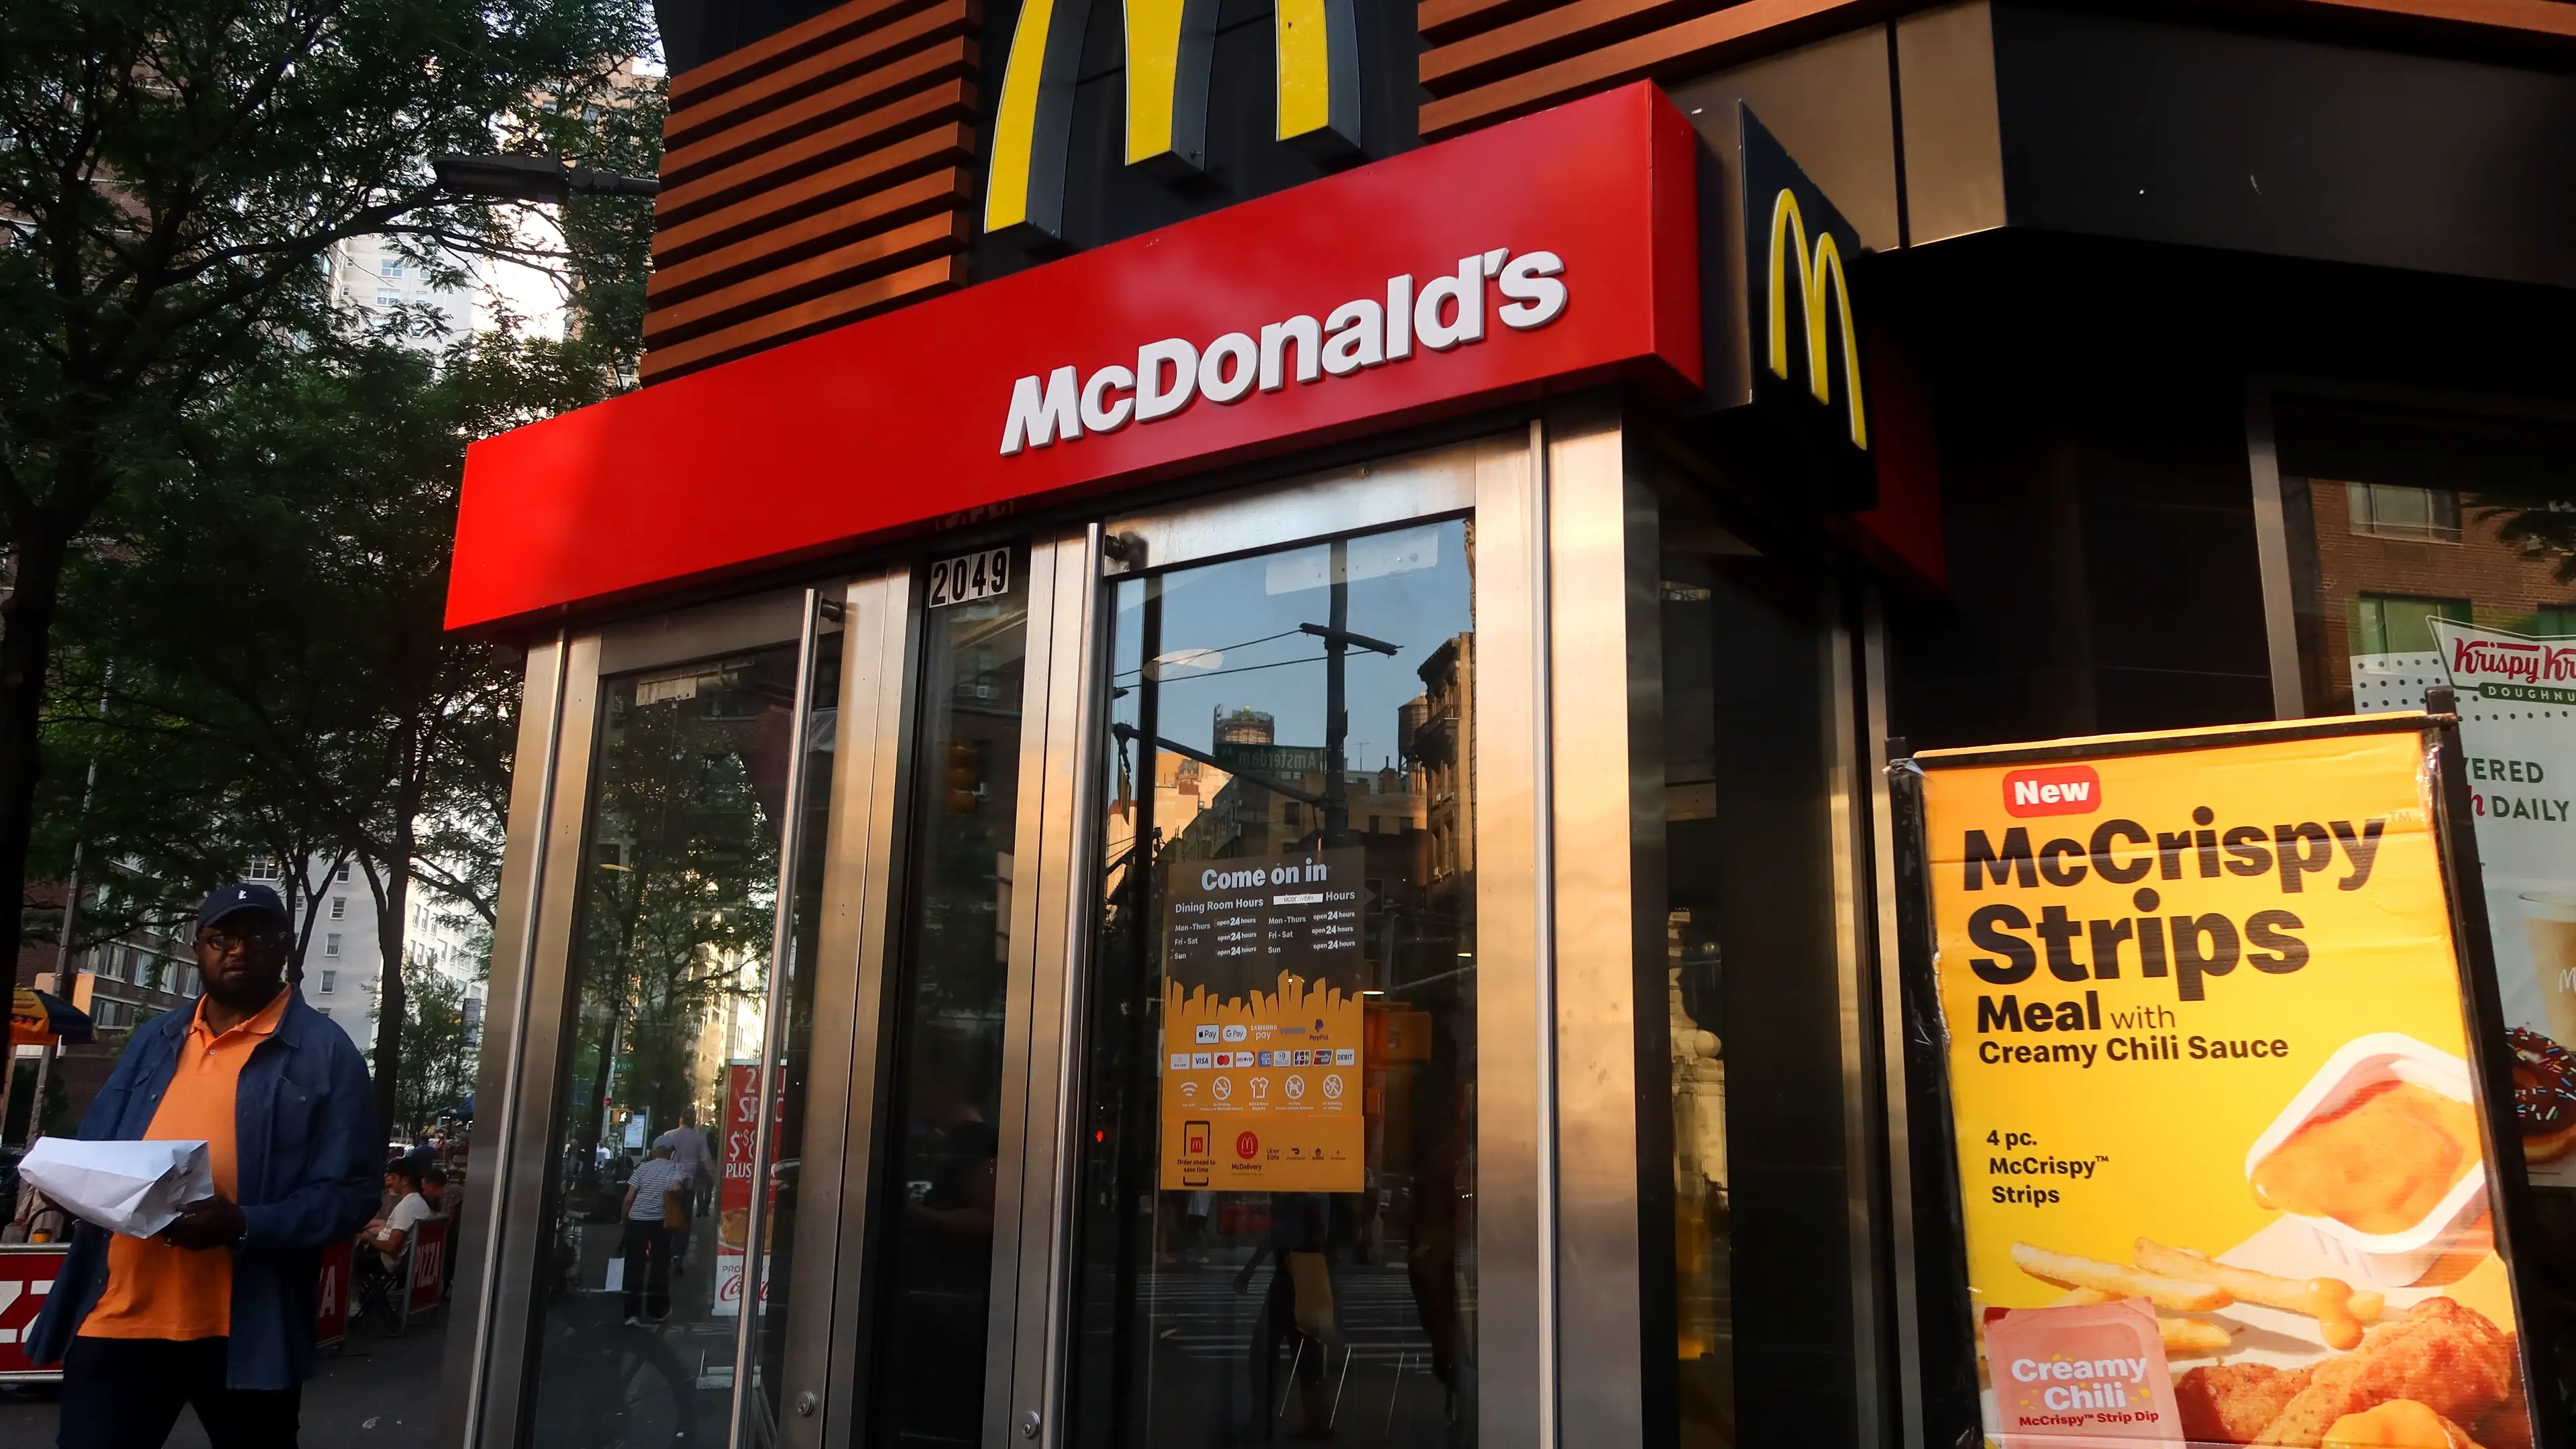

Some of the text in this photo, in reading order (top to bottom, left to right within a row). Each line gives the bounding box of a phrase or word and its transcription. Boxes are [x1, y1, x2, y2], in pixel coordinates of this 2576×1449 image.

[1000, 247, 1568, 457] McDonald's
[931, 550, 1008, 606] 2049
[2453, 637, 2576, 684] Krispy Kr
[2487, 685, 2576, 702] DOUGHNU
[2014, 780, 2090, 806] New
[2492, 796, 2571, 822] DAILY
[1201, 857, 1327, 891] Come on in
[1175, 898, 1264, 914] Dining Room Hours
[1326, 892, 1355, 901] Hours
[1174, 952, 1187, 960] Sun
[1968, 888, 2310, 1002] Strips
[1977, 990, 2176, 1034] Meal with
[1233, 1030, 1244, 1039] Pay
[1256, 1032, 1271, 1040] pay
[1309, 1034, 1329, 1042] PayPal
[1978, 1035, 2289, 1068] Creamy Chili Sauce
[1986, 1130, 2037, 1151] 4 pc.
[725, 1163, 752, 1179] PLUS
[1992, 1184, 2060, 1208] Strips
[2012, 1357, 2147, 1383] Creamy
[2044, 1381, 2126, 1411] Chili
[2097, 1413, 2131, 1424] Strip
[2135, 1411, 2159, 1424] Dip
